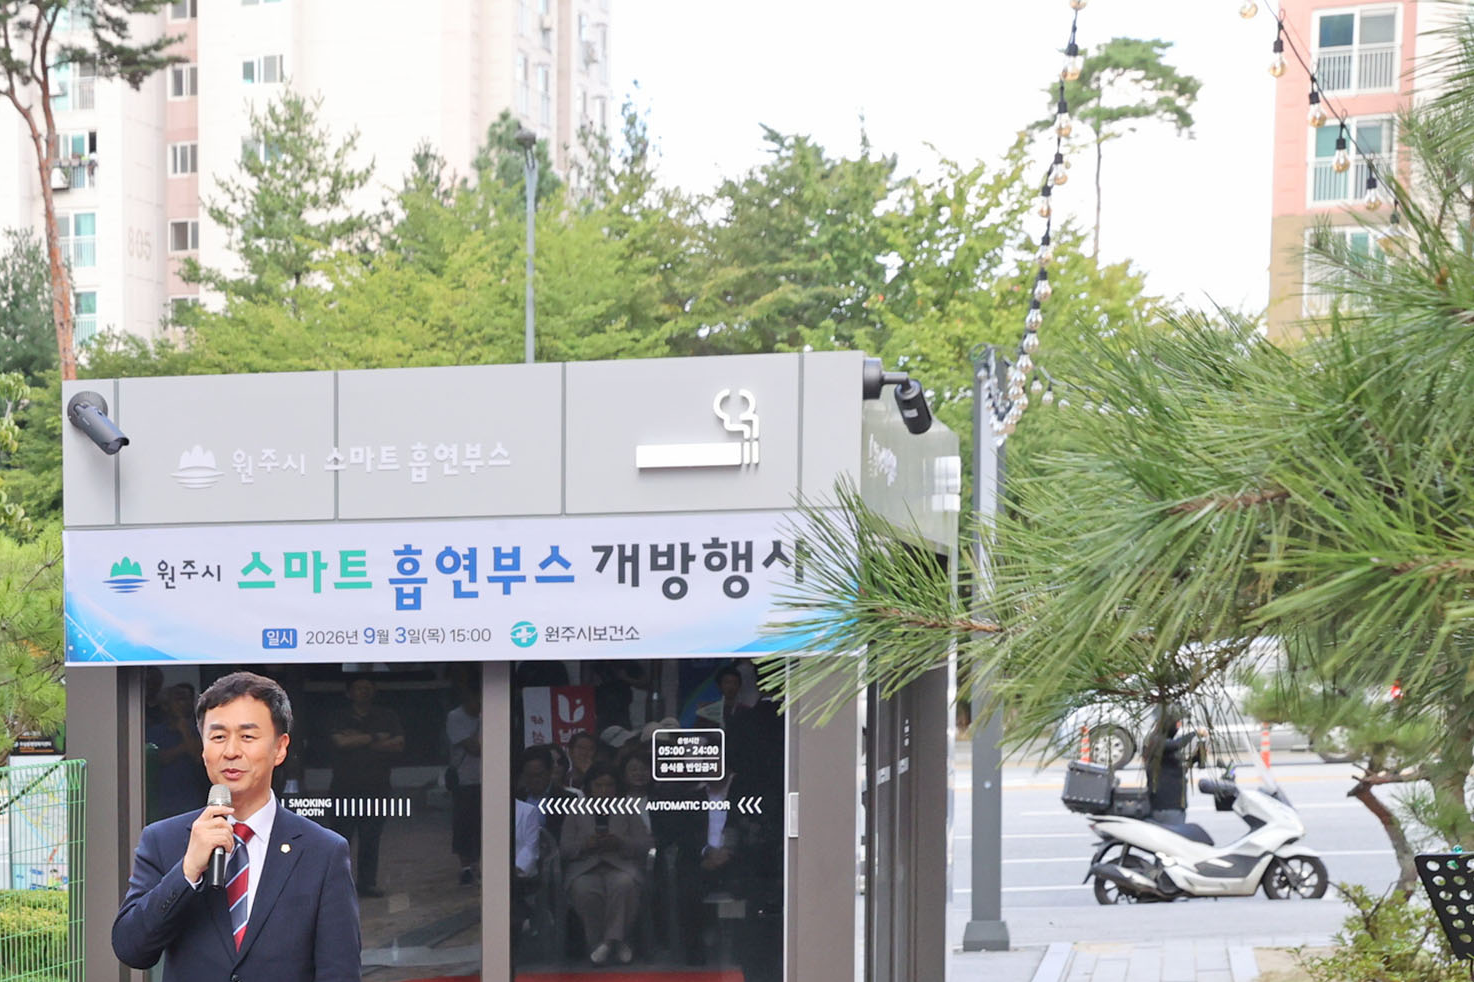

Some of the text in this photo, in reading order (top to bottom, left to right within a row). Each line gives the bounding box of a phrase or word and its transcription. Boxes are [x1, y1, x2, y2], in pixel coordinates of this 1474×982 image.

[231, 441, 511, 484] 원주시 스마트 흡연부스
[156, 535, 811, 612] 원주시 스마트 흡연부스 개방행사
[264, 626, 492, 648] 일시 2026년 9월 3일(목) 15:00
[544, 624, 640, 645] 원주시보건소
[658, 746, 685, 756] 05:00
[692, 746, 719, 756] 24:00
[288, 798, 332, 808] SMOKING
[645, 801, 731, 811] AUTOMATIC DOOR
[296, 808, 325, 817] BOOTH
